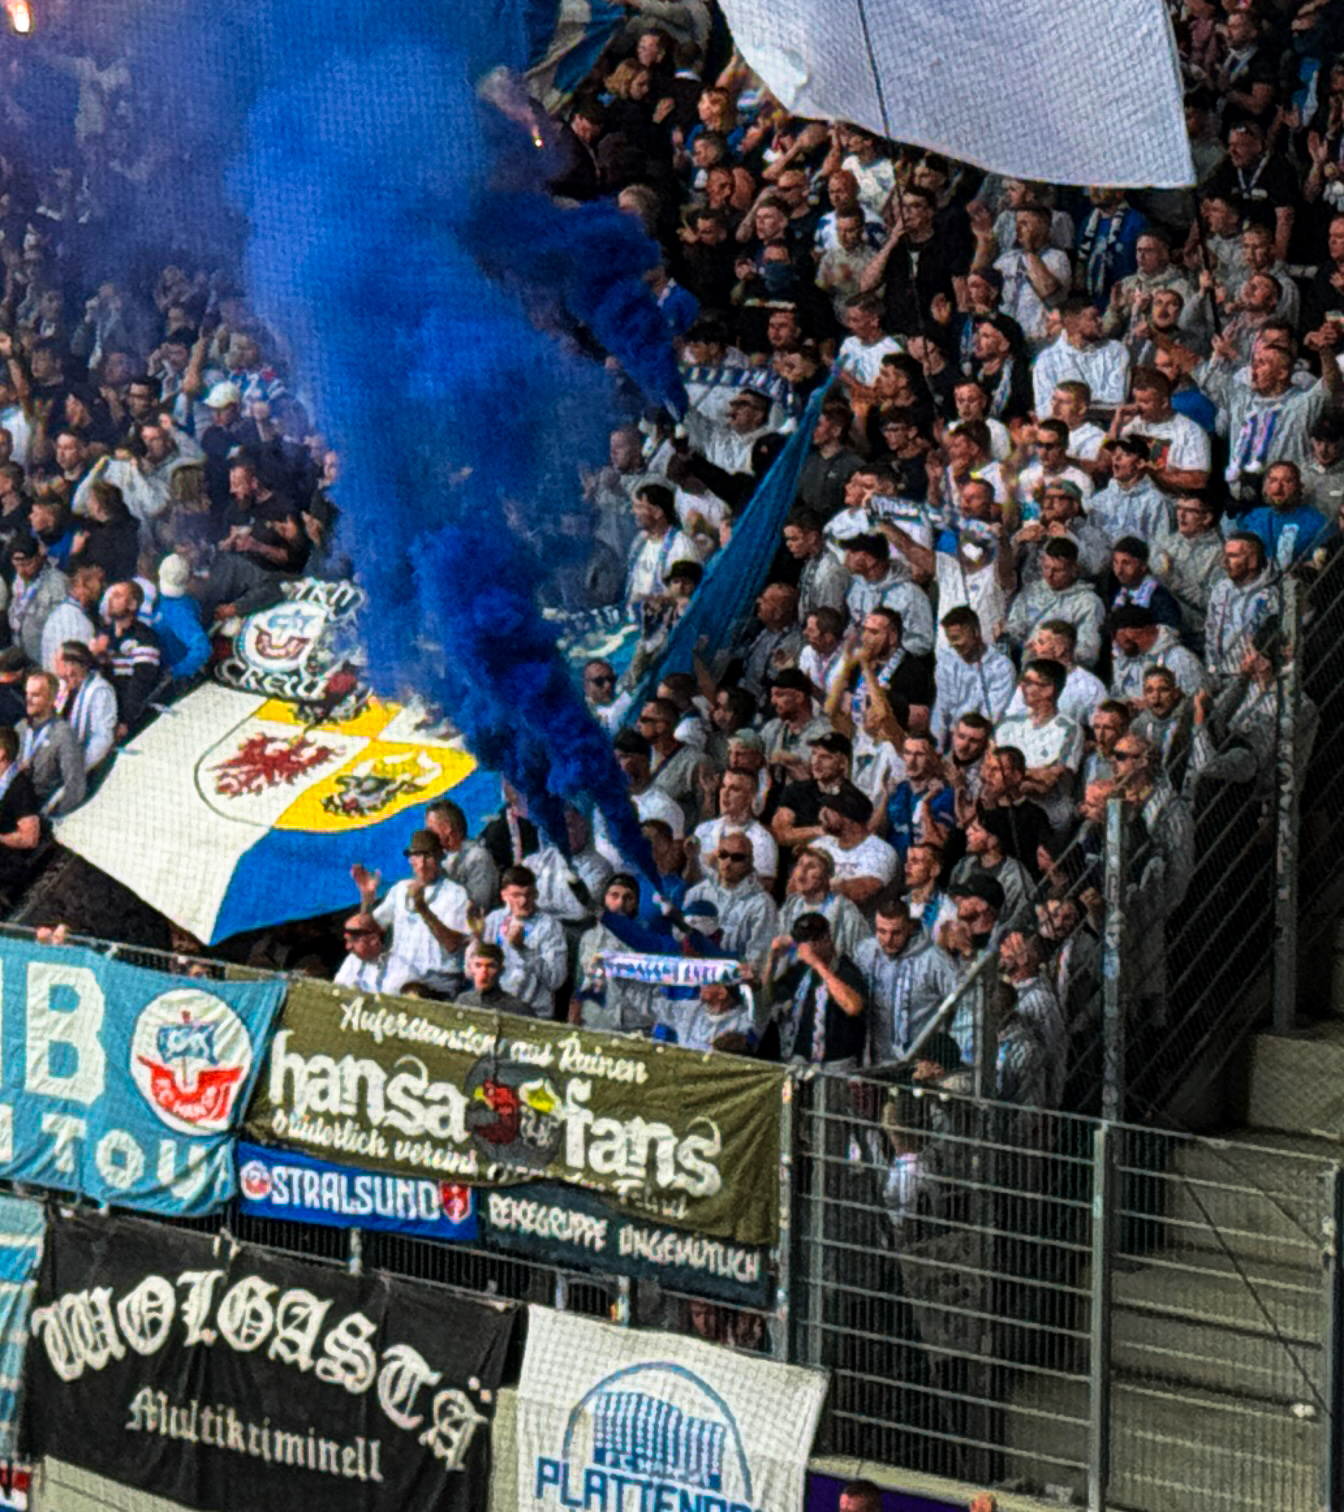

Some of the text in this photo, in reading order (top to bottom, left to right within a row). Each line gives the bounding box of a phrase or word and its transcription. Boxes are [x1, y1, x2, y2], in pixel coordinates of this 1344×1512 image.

[268, 1029, 724, 1198] hansa fans
[271, 1165, 441, 1221] STRALSUND
[125, 1386, 383, 1483] Multikriminell
